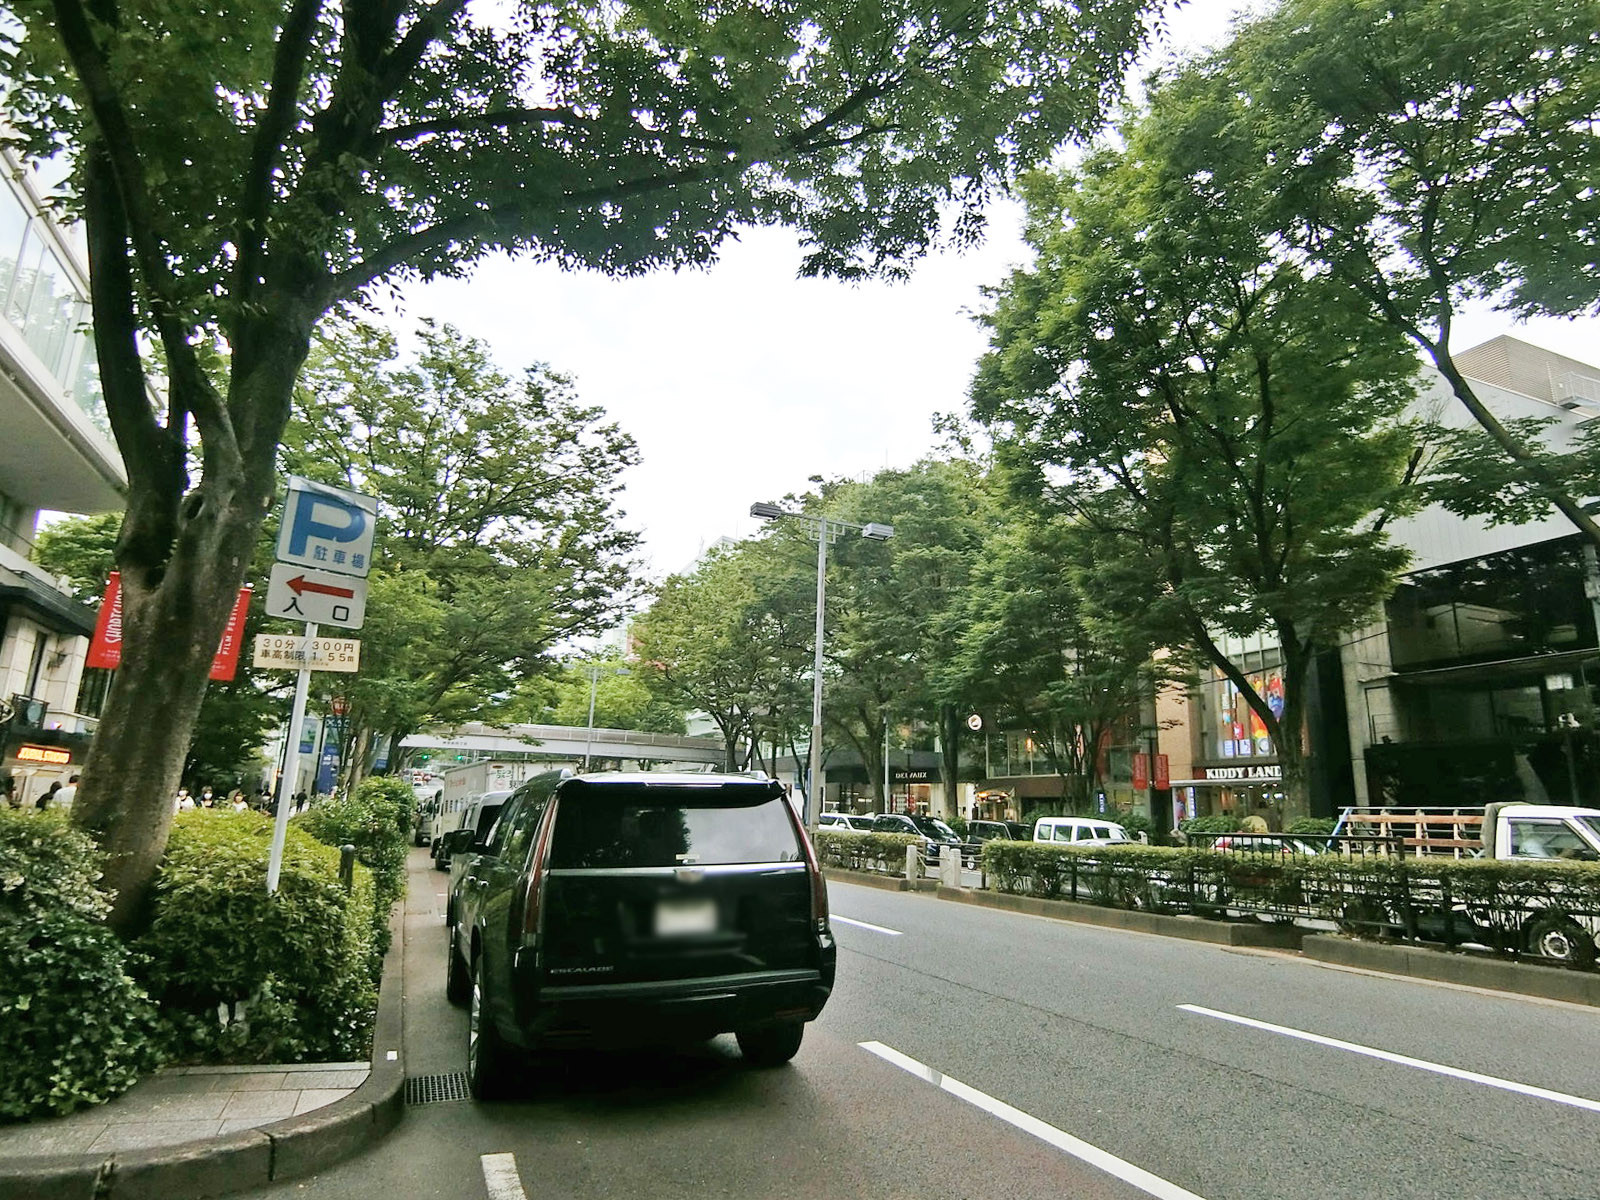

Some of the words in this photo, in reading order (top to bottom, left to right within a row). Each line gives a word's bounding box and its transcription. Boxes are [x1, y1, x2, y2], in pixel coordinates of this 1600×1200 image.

[289, 492, 366, 557] P
[313, 545, 365, 569] 駐車場
[283, 597, 349, 621] 入口
[222, 635, 232, 655] FILM
[1206, 767, 1246, 779] KIDDY
